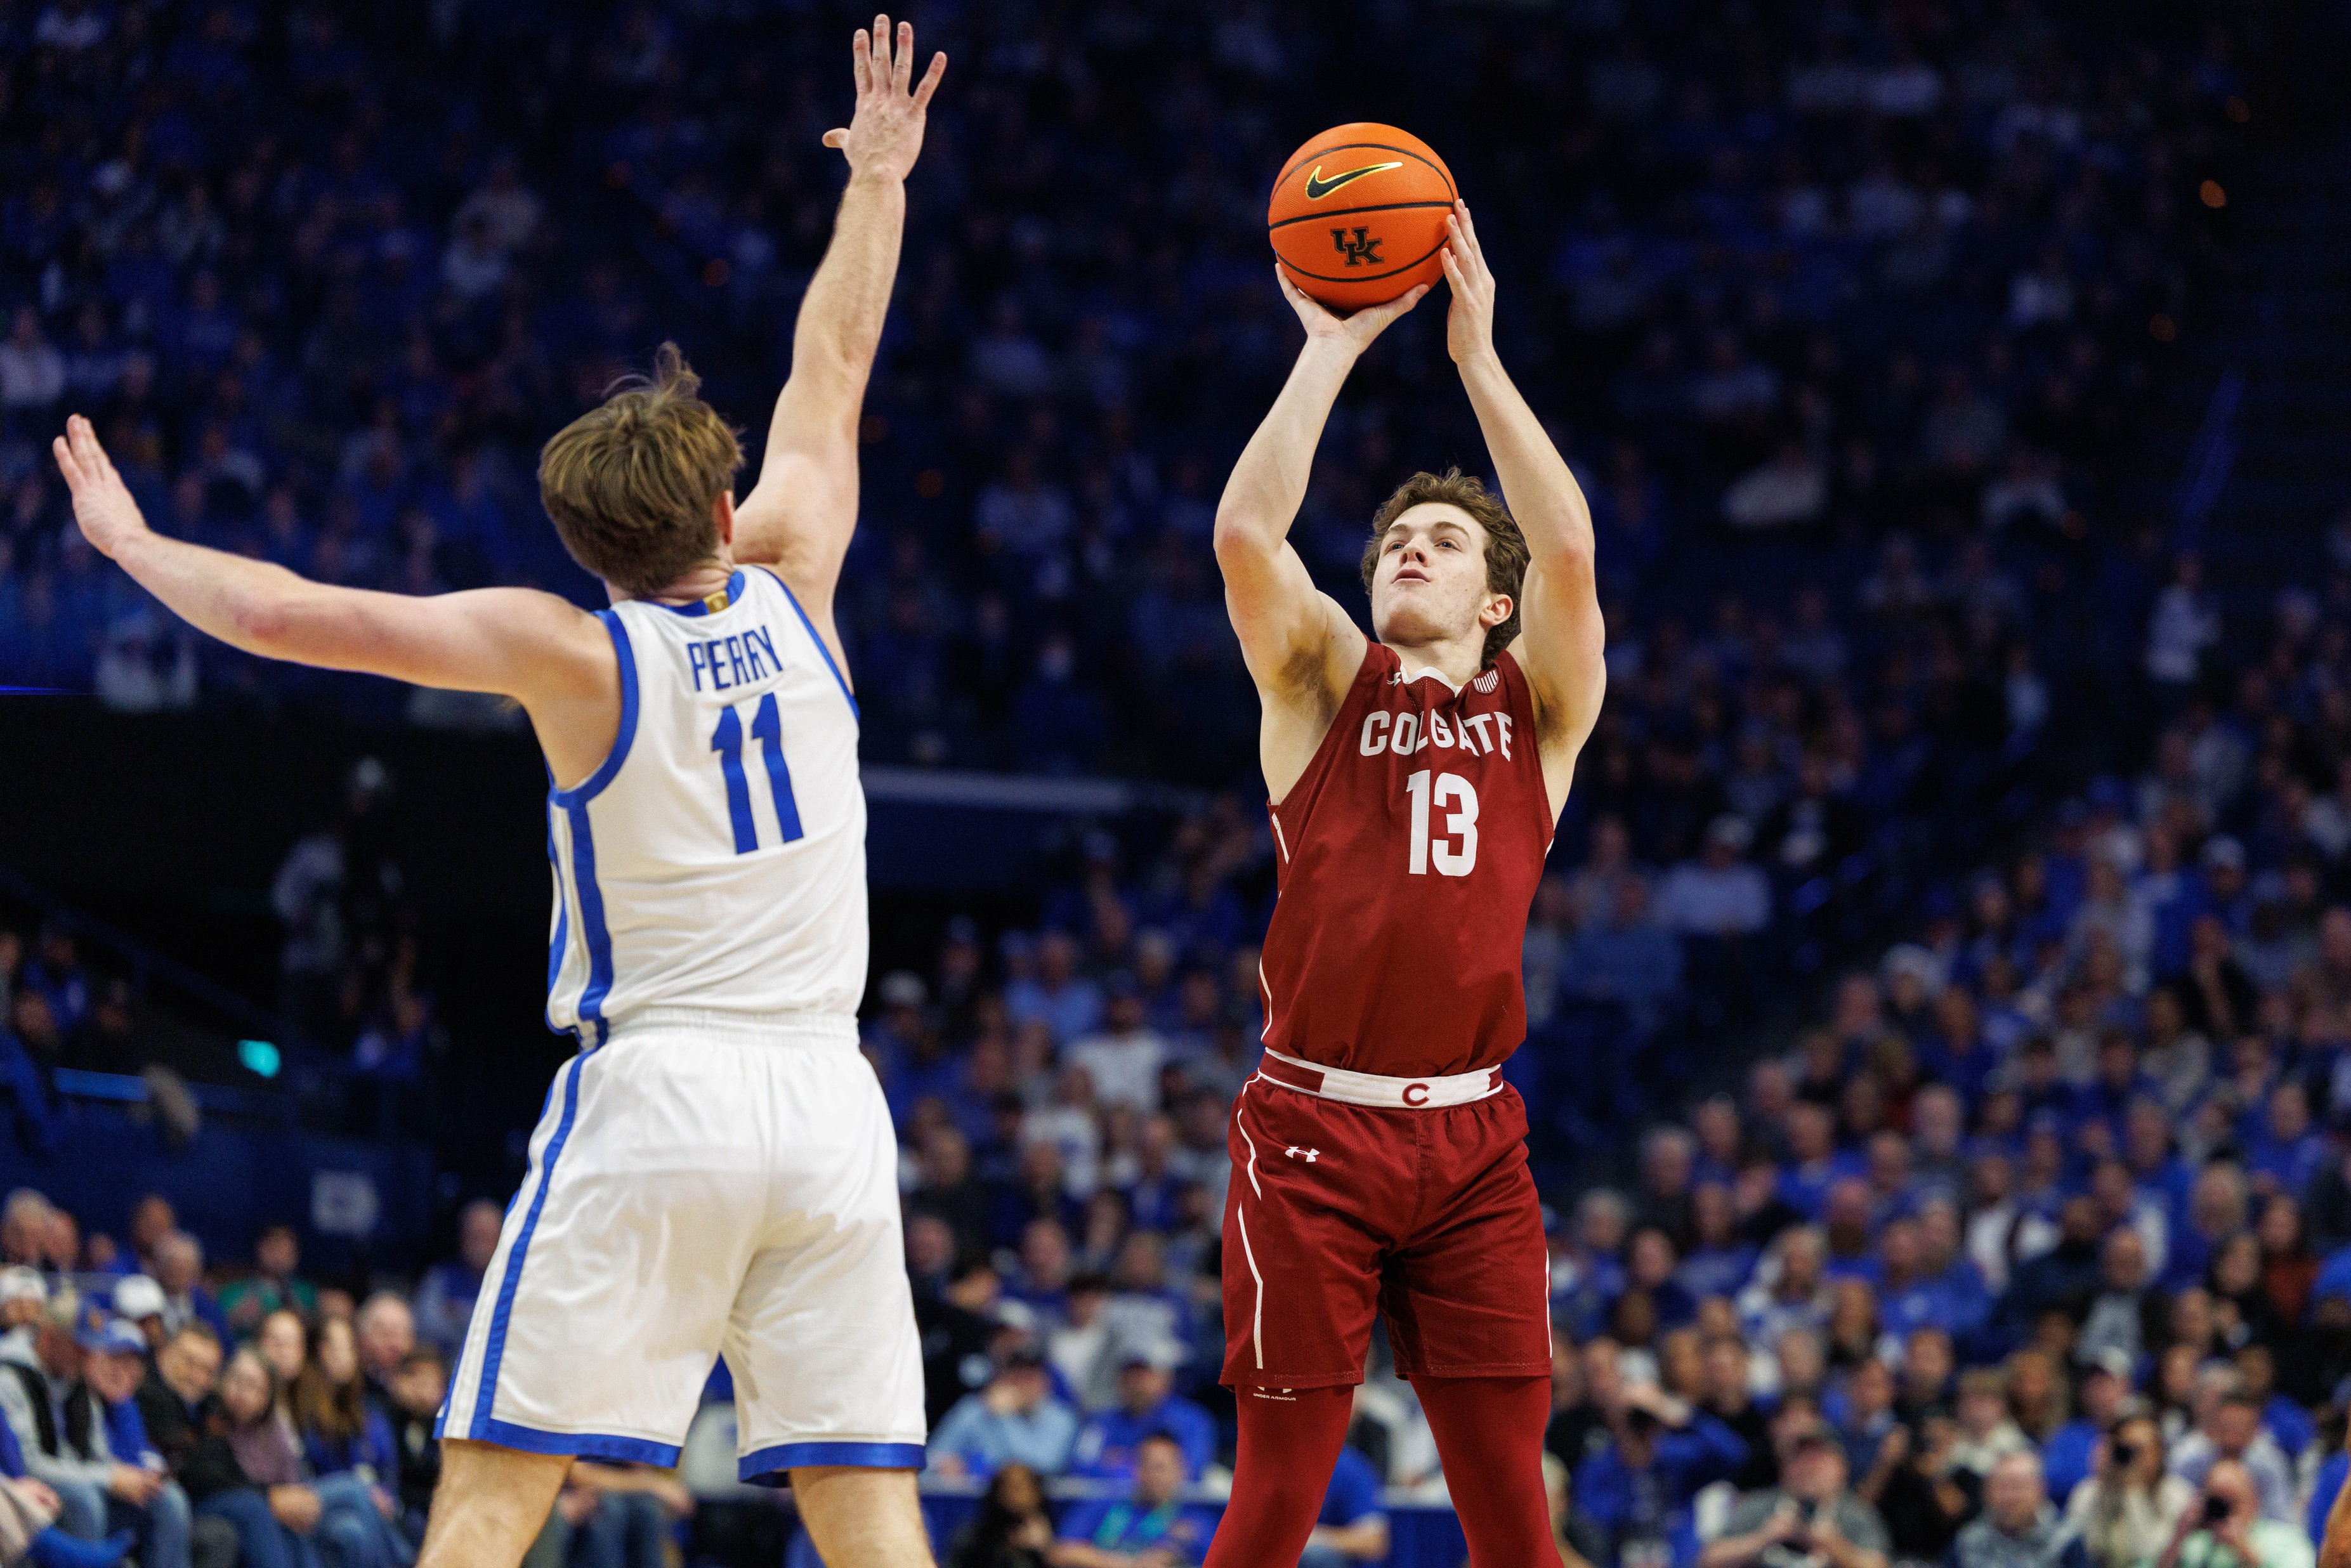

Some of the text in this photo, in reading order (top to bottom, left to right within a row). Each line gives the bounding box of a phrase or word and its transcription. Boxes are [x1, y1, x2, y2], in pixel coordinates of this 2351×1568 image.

[687, 625, 783, 691] PERRY
[1360, 709, 1512, 762] COLGATE
[711, 692, 804, 855] 11
[1406, 769, 1479, 877] 13
[1402, 1083, 1430, 1107] C
